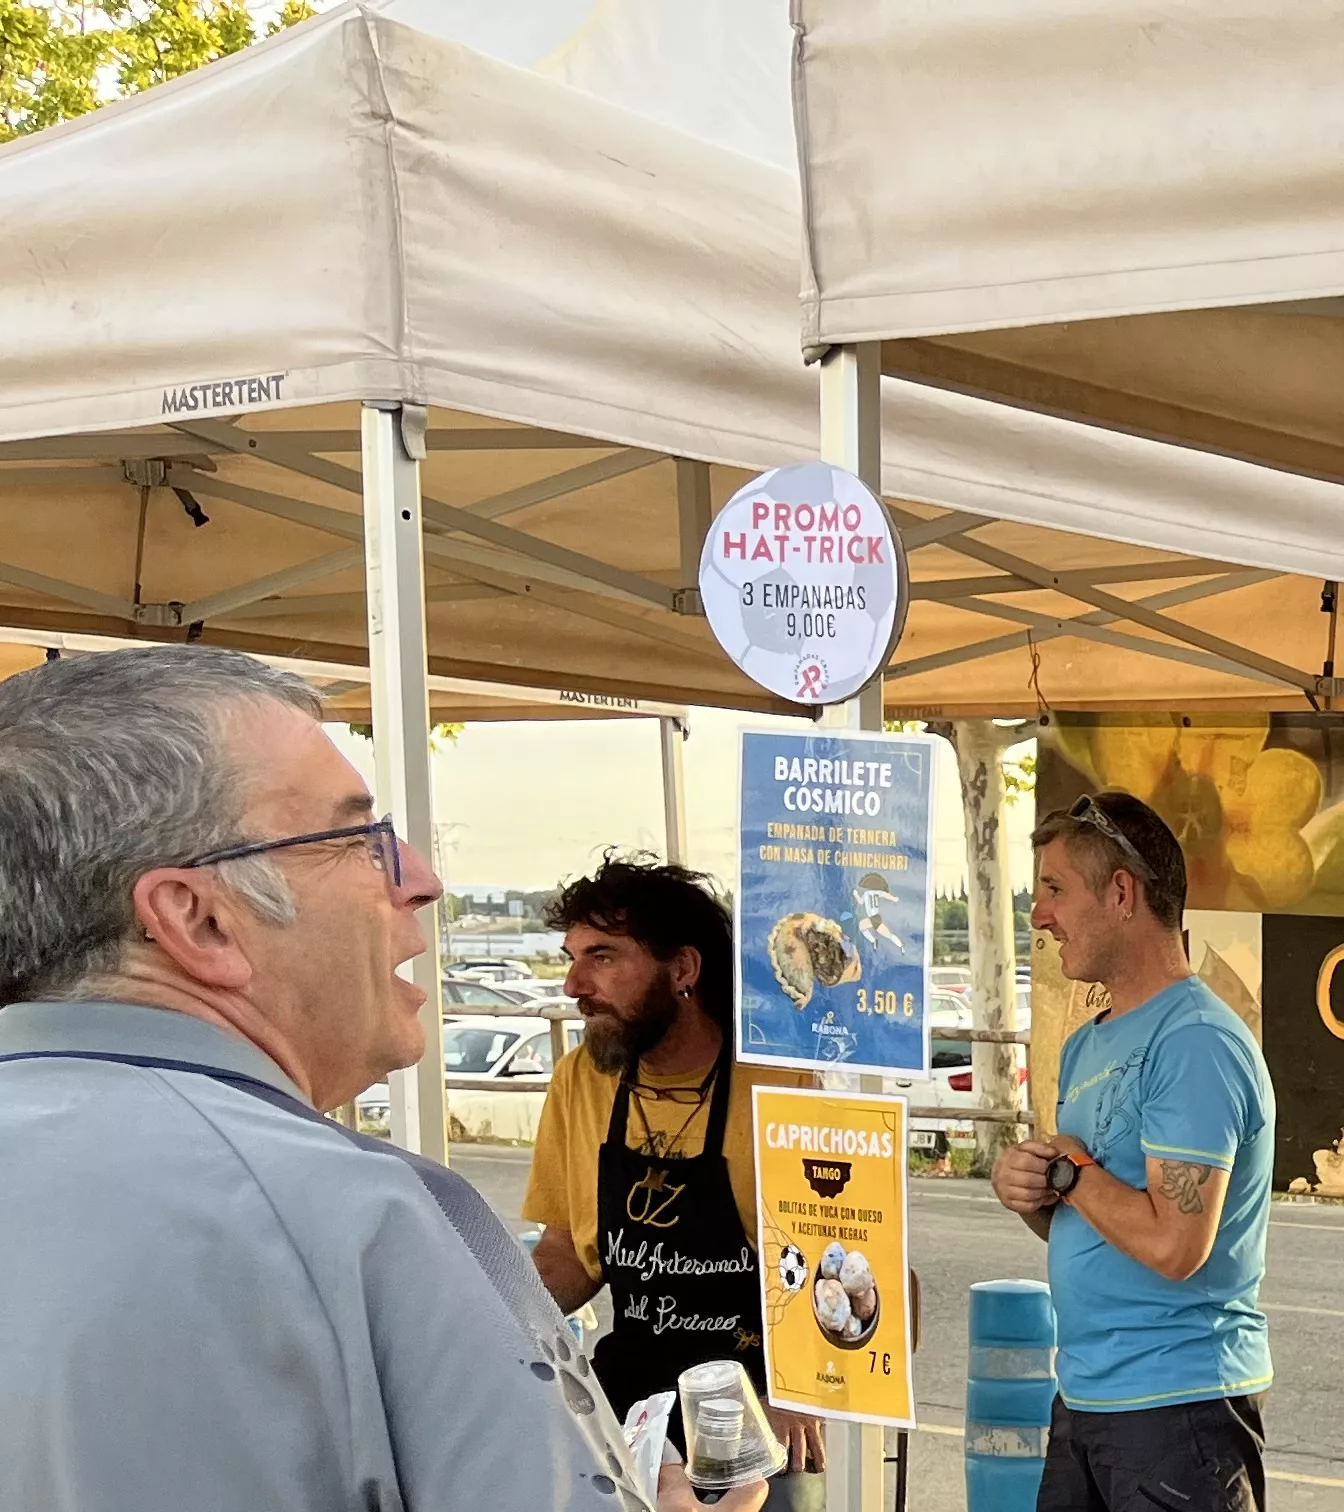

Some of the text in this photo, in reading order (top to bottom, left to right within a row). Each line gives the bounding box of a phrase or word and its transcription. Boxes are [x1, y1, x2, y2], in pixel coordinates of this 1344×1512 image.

[162, 375, 285, 414] MASTERTENT
[752, 502, 862, 532] PROMO
[723, 532, 885, 564] HAT-TRICK
[742, 582, 866, 610] 3 EMPANADAS
[787, 613, 836, 639] 9,00€
[560, 690, 638, 709] MASTERTENT
[774, 756, 892, 788] BARRILETE
[783, 781, 881, 817] CÓSMICO
[767, 822, 897, 847] EMPANADA DE TERNERA
[759, 844, 909, 871] CON MASA DE CHIMICHURRI
[868, 894, 880, 909] 10
[856, 989, 914, 1017] 3,50 €
[811, 1022, 849, 1037] RABONA
[765, 1121, 894, 1159] CAPRICHOSAS
[812, 1165, 841, 1182] TANGO
[627, 1168, 686, 1228] OZ
[778, 1200, 883, 1224] BOLITAS DE YUCA CON QUESO
[791, 1220, 868, 1242] Y ACEITUNAS NEGRAS
[640, 1242, 754, 1281] Artesanal
[625, 1294, 649, 1321] del
[868, 1351, 891, 1376] 7 €
[816, 1371, 846, 1385] RABONA
